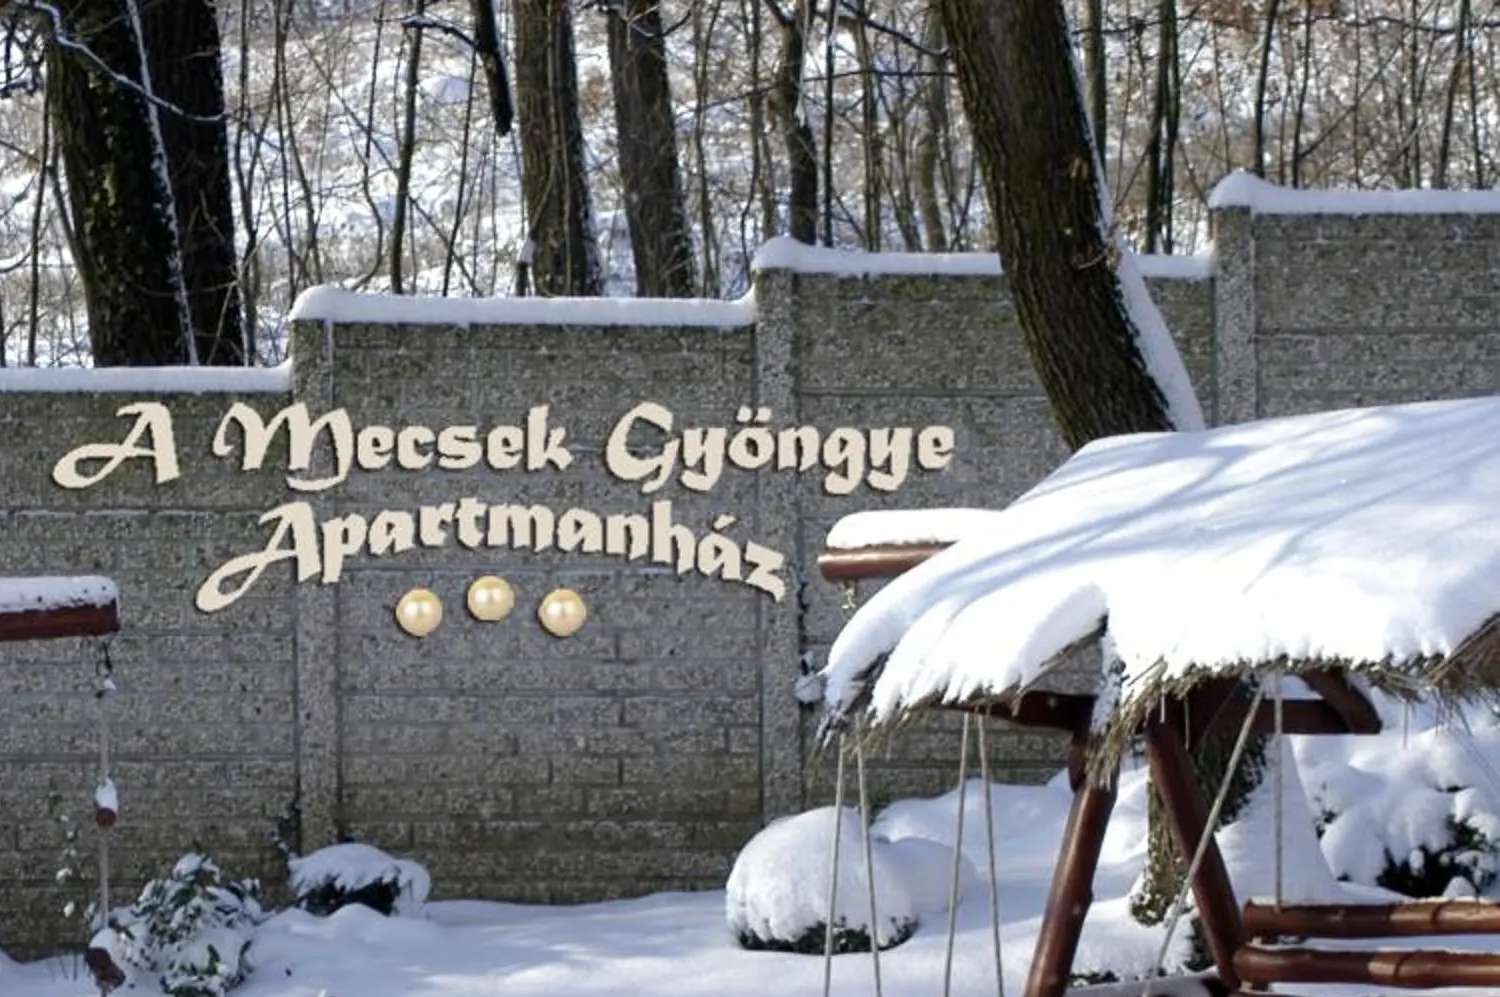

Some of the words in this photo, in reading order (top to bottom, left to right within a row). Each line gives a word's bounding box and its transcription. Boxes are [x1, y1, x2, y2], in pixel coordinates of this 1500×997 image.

[53, 402, 180, 488] A
[213, 402, 573, 491] Mecsek
[606, 402, 956, 495] Gyöngye
[196, 497, 785, 612] Apartmanház
